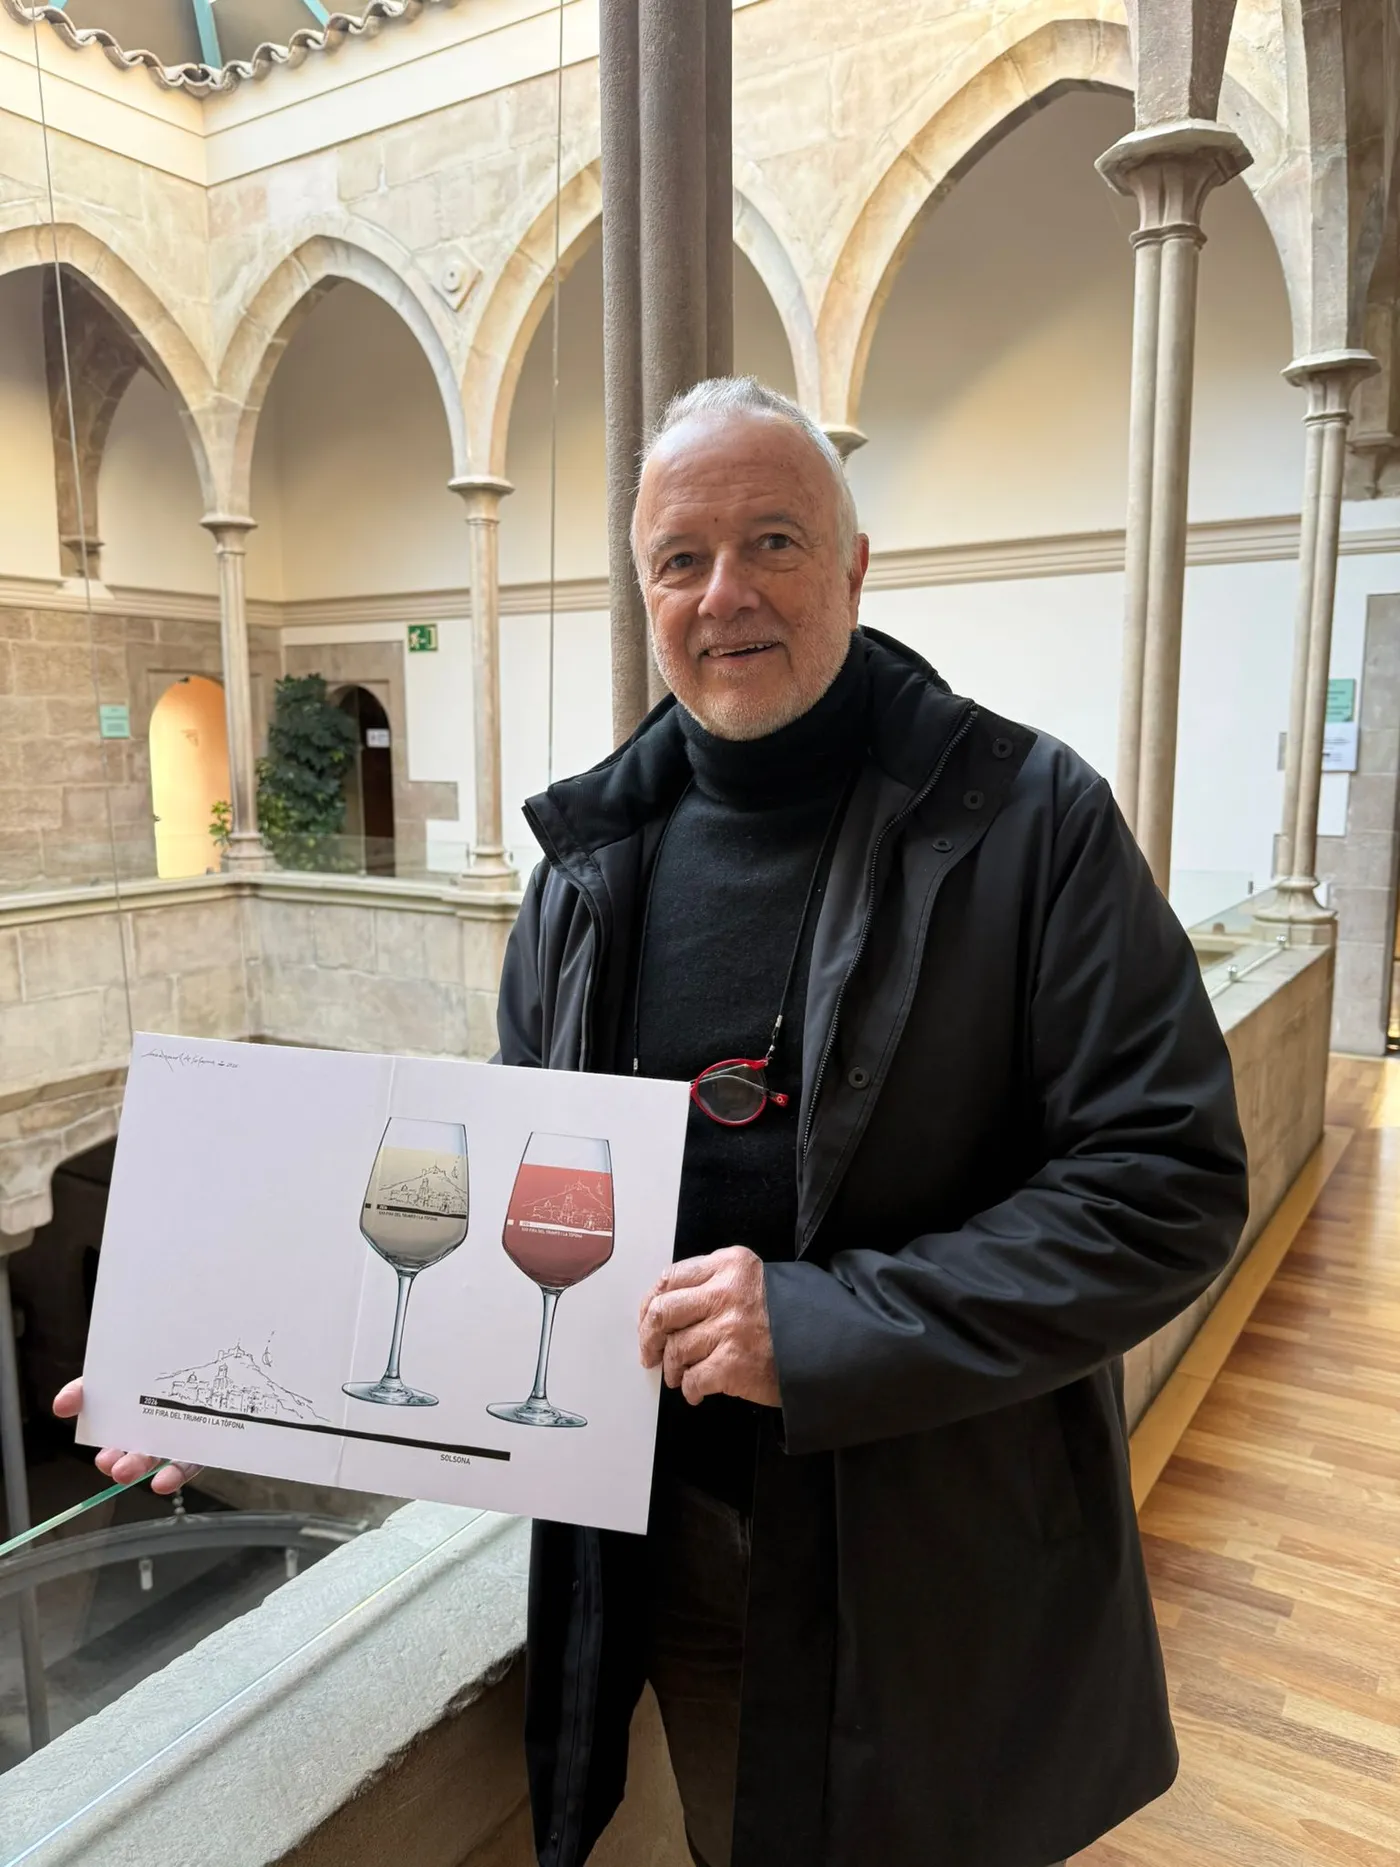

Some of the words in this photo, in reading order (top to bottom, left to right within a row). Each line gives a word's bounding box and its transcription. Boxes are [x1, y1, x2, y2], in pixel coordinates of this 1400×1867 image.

[143, 1397, 158, 1406] 2026
[154, 1408, 169, 1418] FIRA
[170, 1411, 182, 1420] DEL
[183, 1413, 208, 1424] TRUMFO
[440, 1454, 470, 1464] SOLSONA
